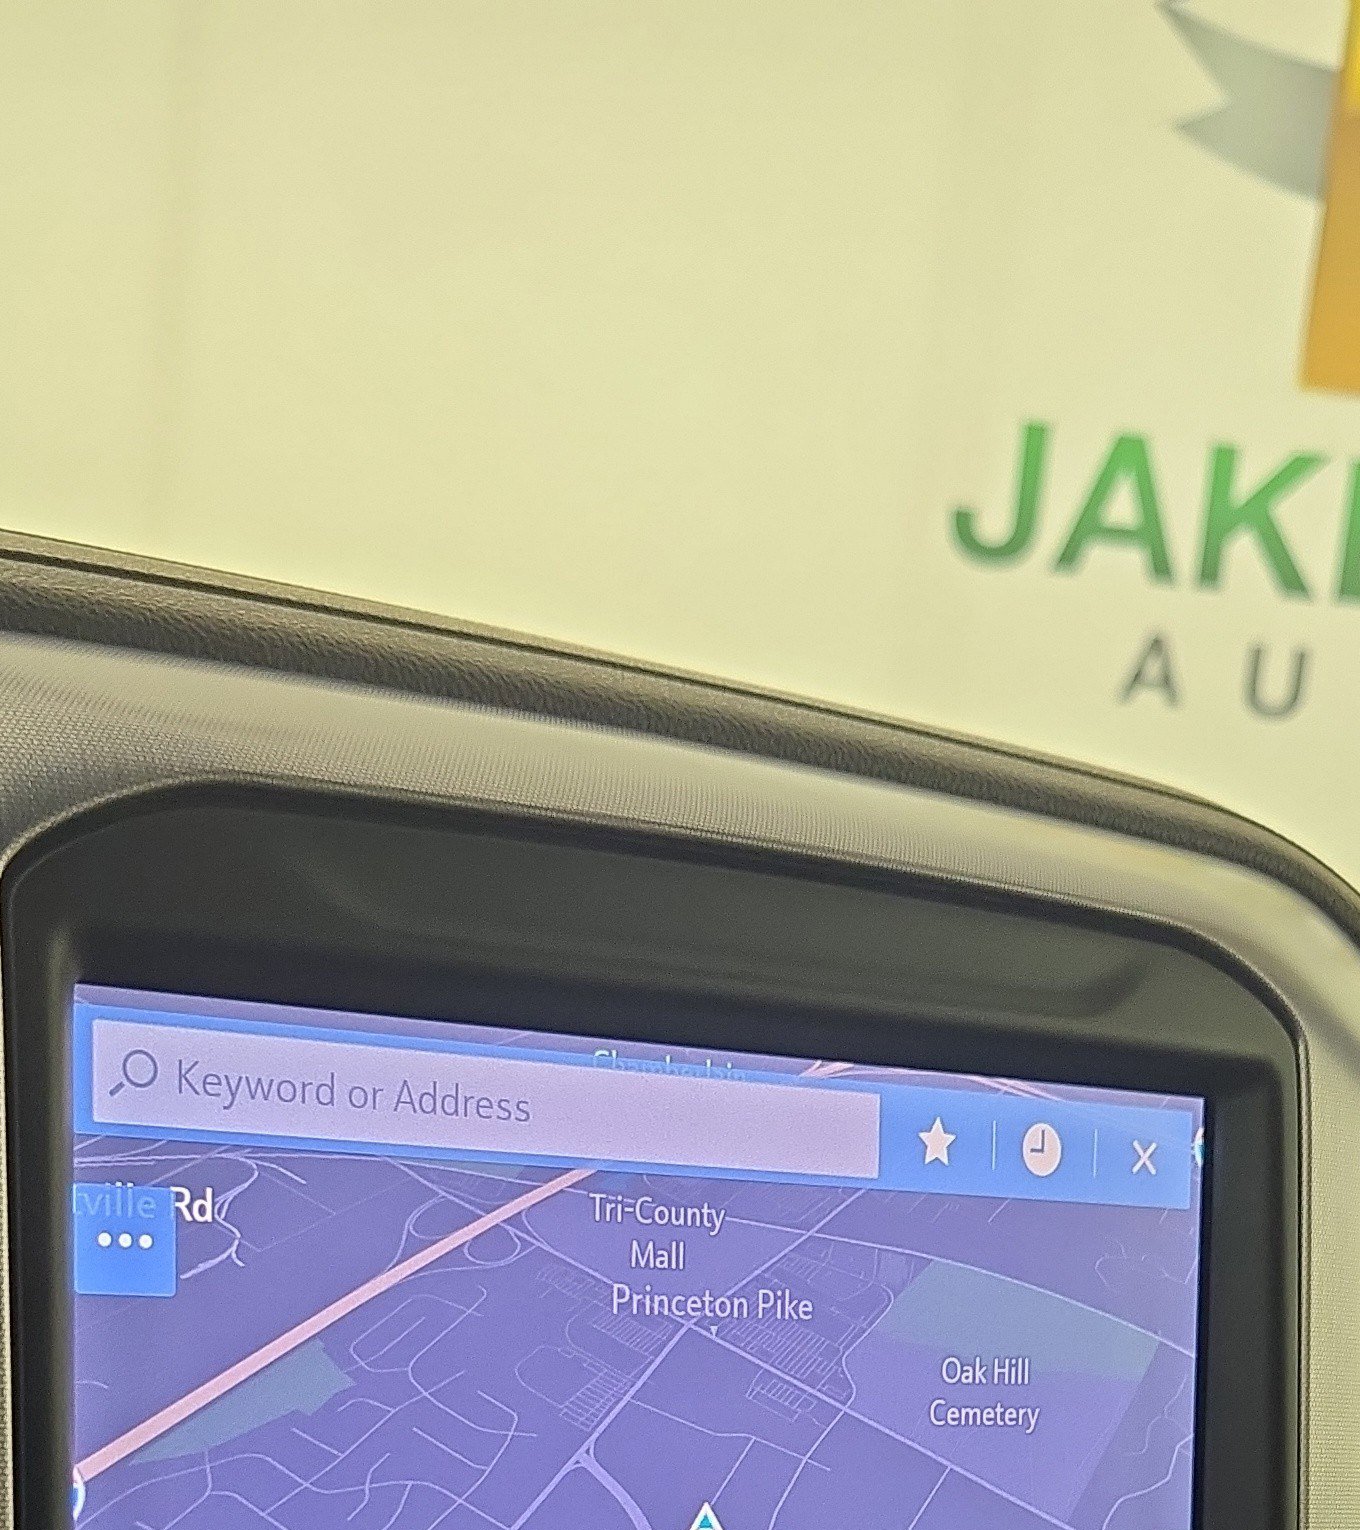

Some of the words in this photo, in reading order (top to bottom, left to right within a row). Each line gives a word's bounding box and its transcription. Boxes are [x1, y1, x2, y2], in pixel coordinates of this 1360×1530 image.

[176, 1058, 336, 1111] Keyword
[347, 1084, 385, 1111] or
[392, 1078, 532, 1123] Address
[589, 1192, 726, 1237] Tri-County
[629, 1240, 686, 1271] Mall
[611, 1283, 750, 1320] Princeton
[756, 1289, 814, 1321] Pike
[941, 1356, 988, 1387] Oak
[992, 1356, 1031, 1387] Hill
[929, 1398, 1041, 1433] Cemetery
